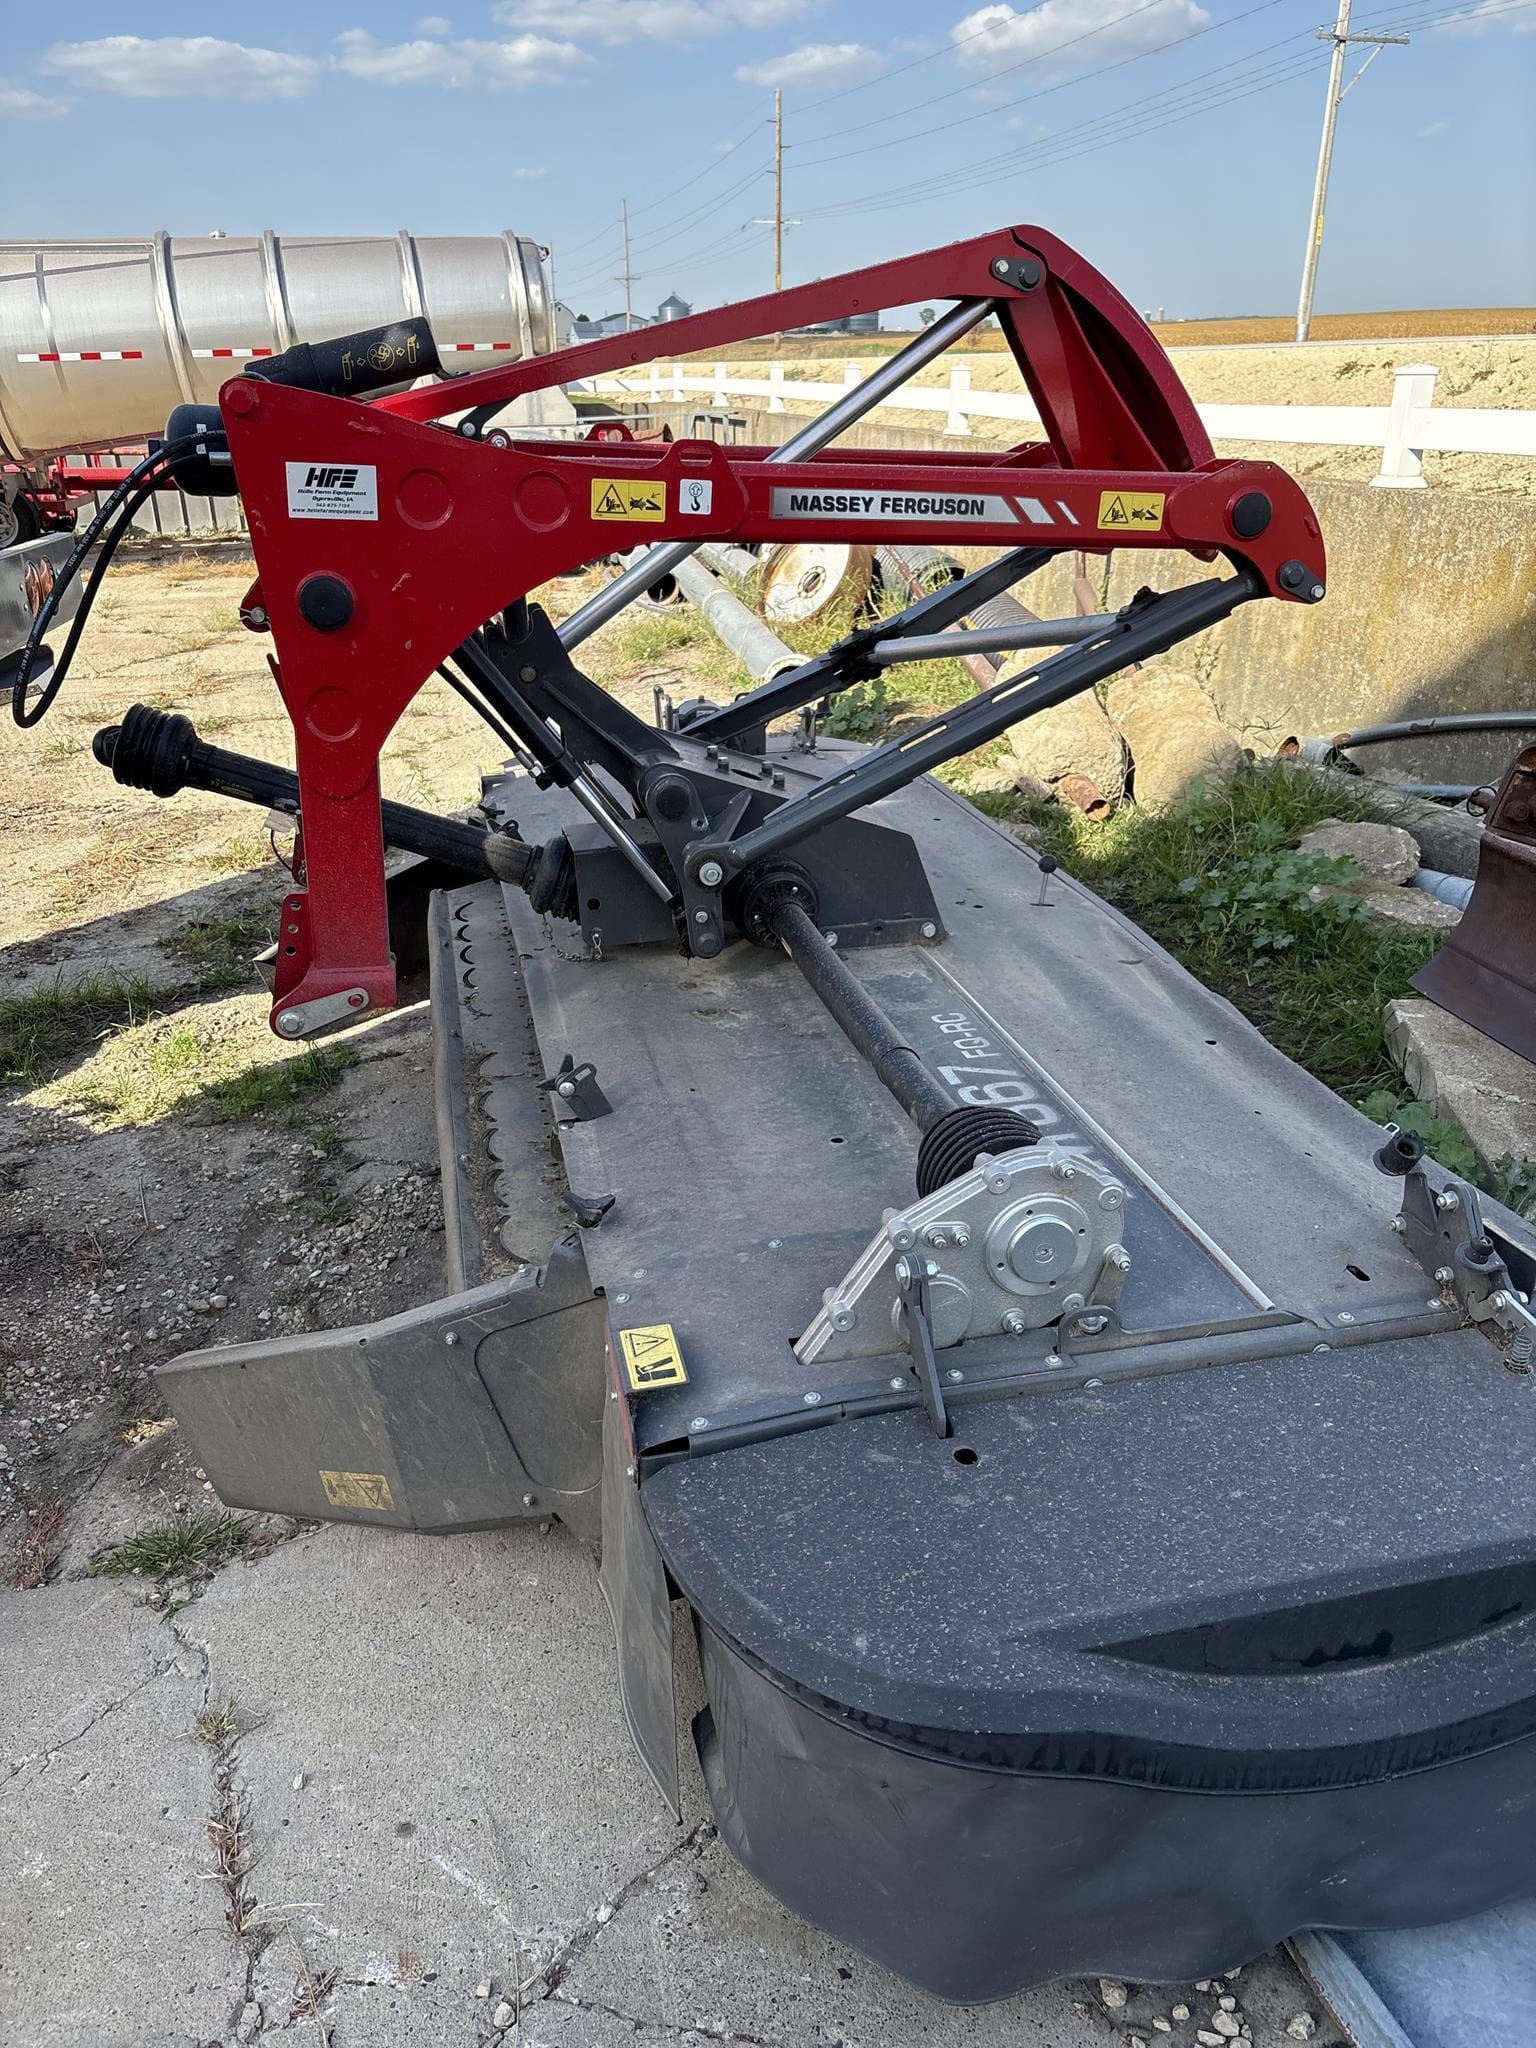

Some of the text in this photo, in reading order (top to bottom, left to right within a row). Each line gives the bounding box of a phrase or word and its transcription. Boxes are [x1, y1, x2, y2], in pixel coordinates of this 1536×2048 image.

[305, 467, 359, 489] HFE
[790, 494, 985, 516] MASSEY FERGUSON
[931, 1012, 1000, 1059] FQ-RC
